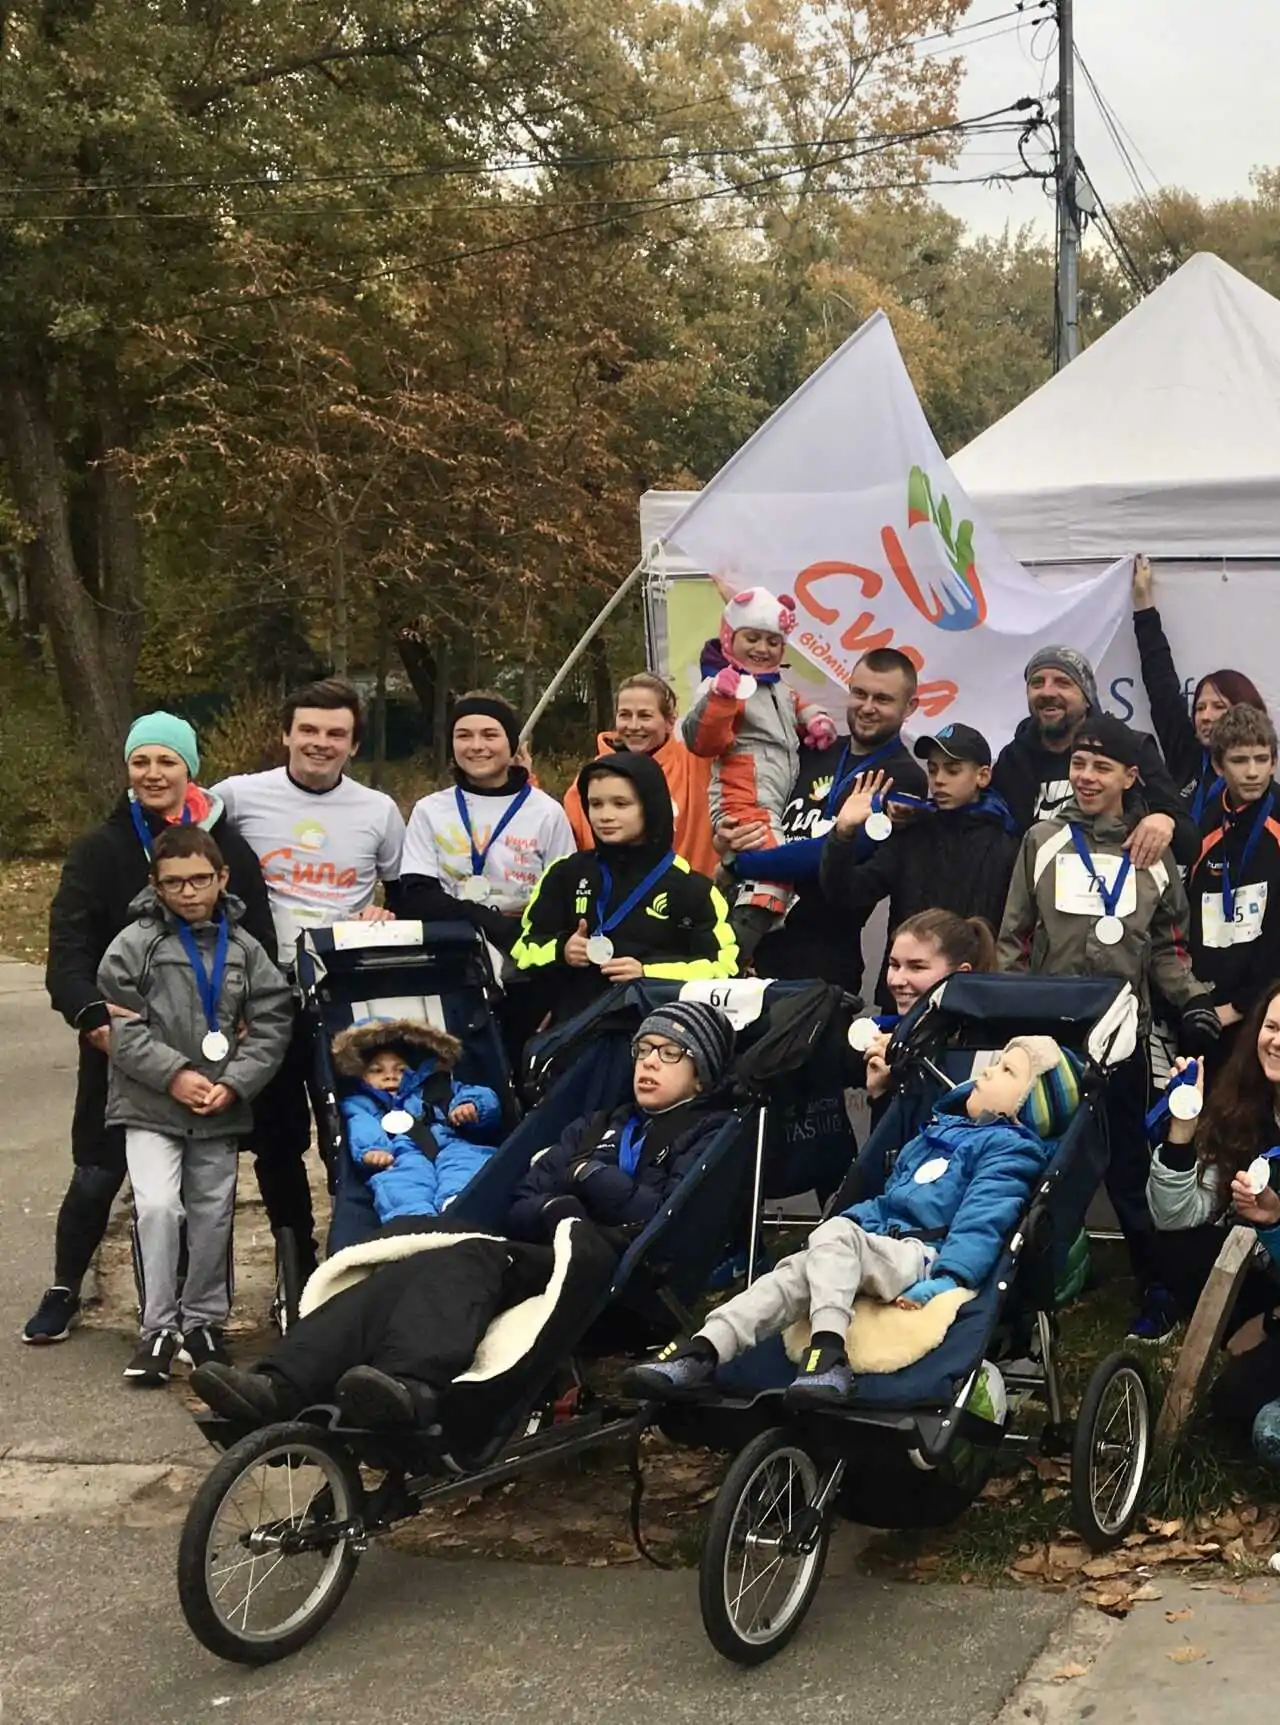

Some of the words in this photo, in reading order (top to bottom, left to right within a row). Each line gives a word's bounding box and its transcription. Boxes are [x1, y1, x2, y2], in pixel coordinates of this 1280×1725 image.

[794, 561, 958, 717] Сиа
[799, 632, 851, 684] відмін
[575, 896, 588, 914] 10
[710, 987, 732, 1007] 67
